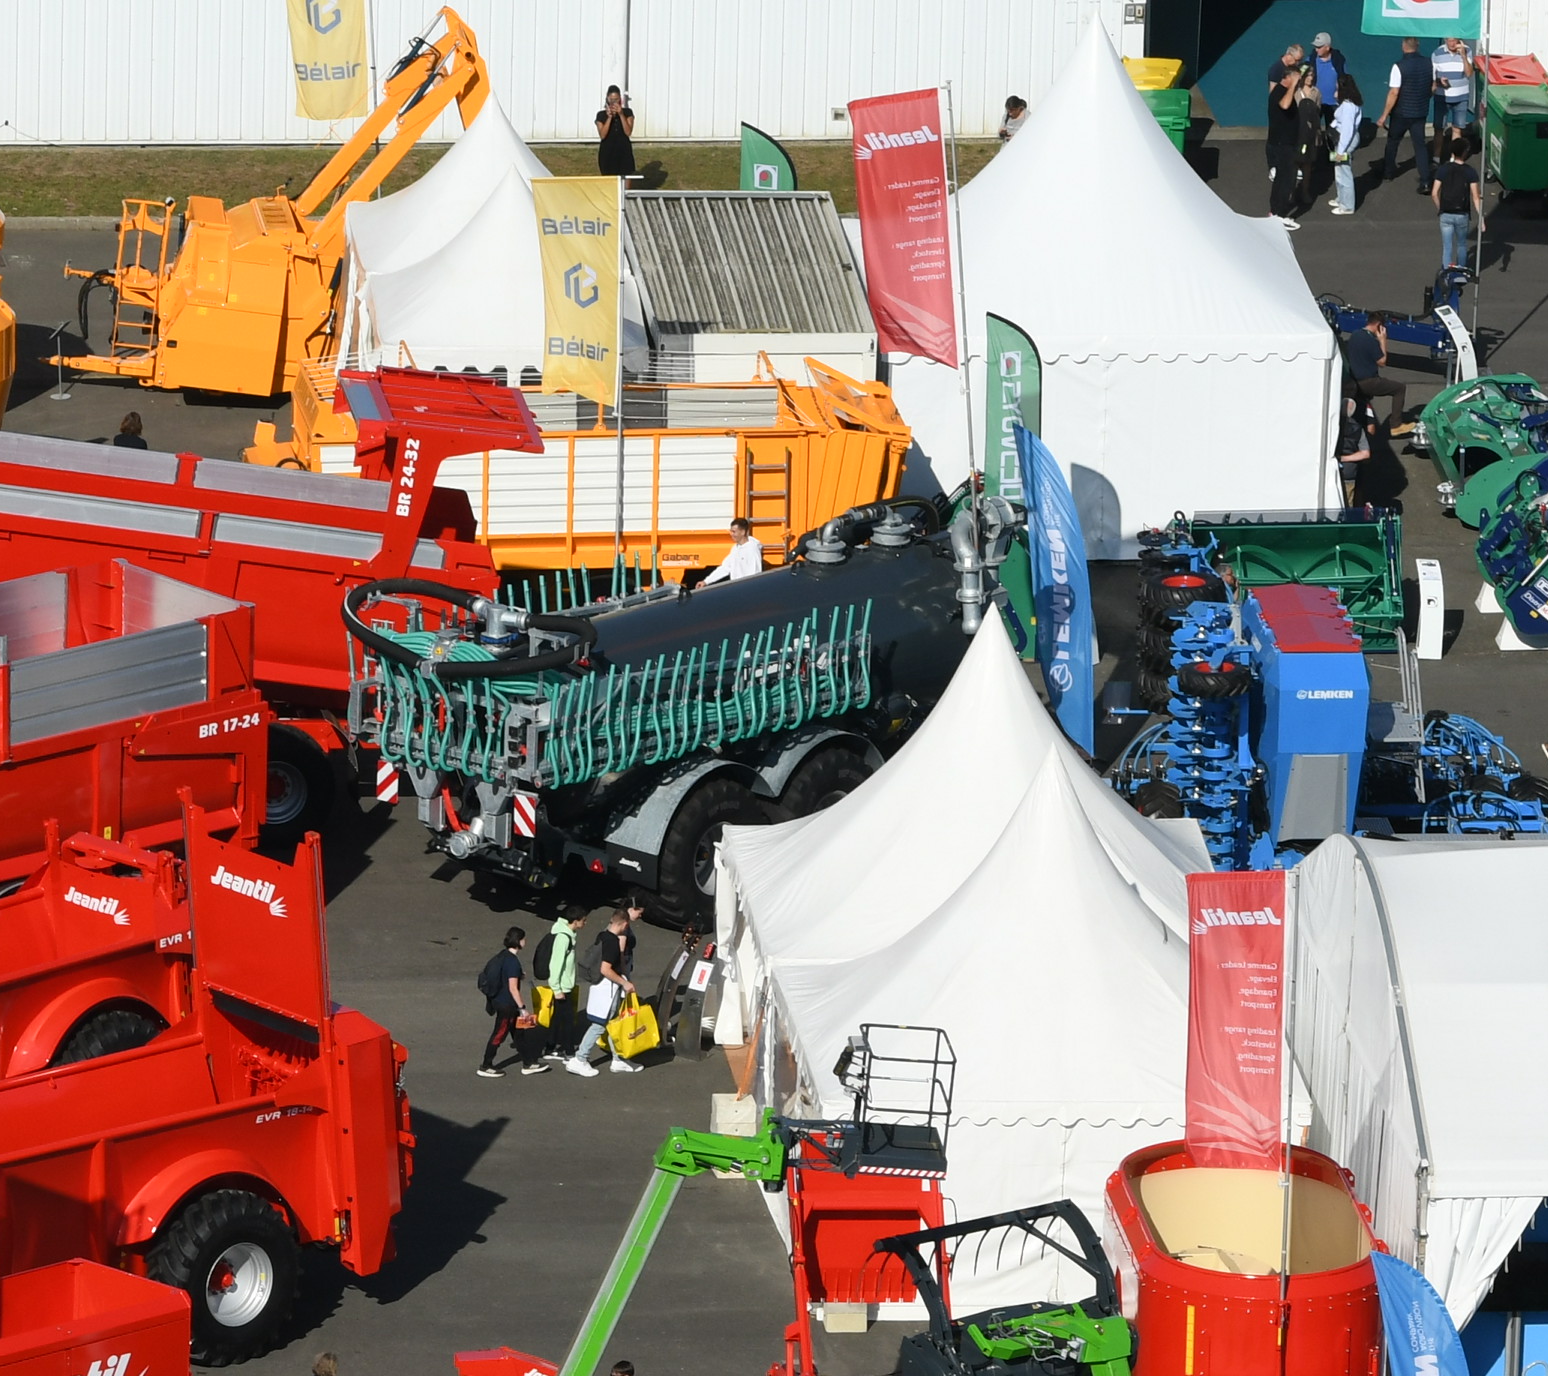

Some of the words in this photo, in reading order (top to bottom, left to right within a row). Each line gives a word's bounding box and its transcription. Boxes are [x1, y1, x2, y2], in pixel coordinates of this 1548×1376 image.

[294, 61, 362, 82] Bélair
[541, 217, 612, 238] Bélair
[548, 336, 609, 362] Bélair
[401, 437, 421, 490] 24-32
[395, 492, 413, 517] BR
[662, 553, 700, 561] Gabare
[1308, 690, 1354, 699] LEMKEN
[199, 723, 218, 738] BR
[222, 713, 261, 733] 17-24
[210, 864, 276, 906] Jeantil
[64, 886, 119, 916] Jeantil
[158, 932, 183, 948] EVR
[255, 1111, 282, 1124] EVR
